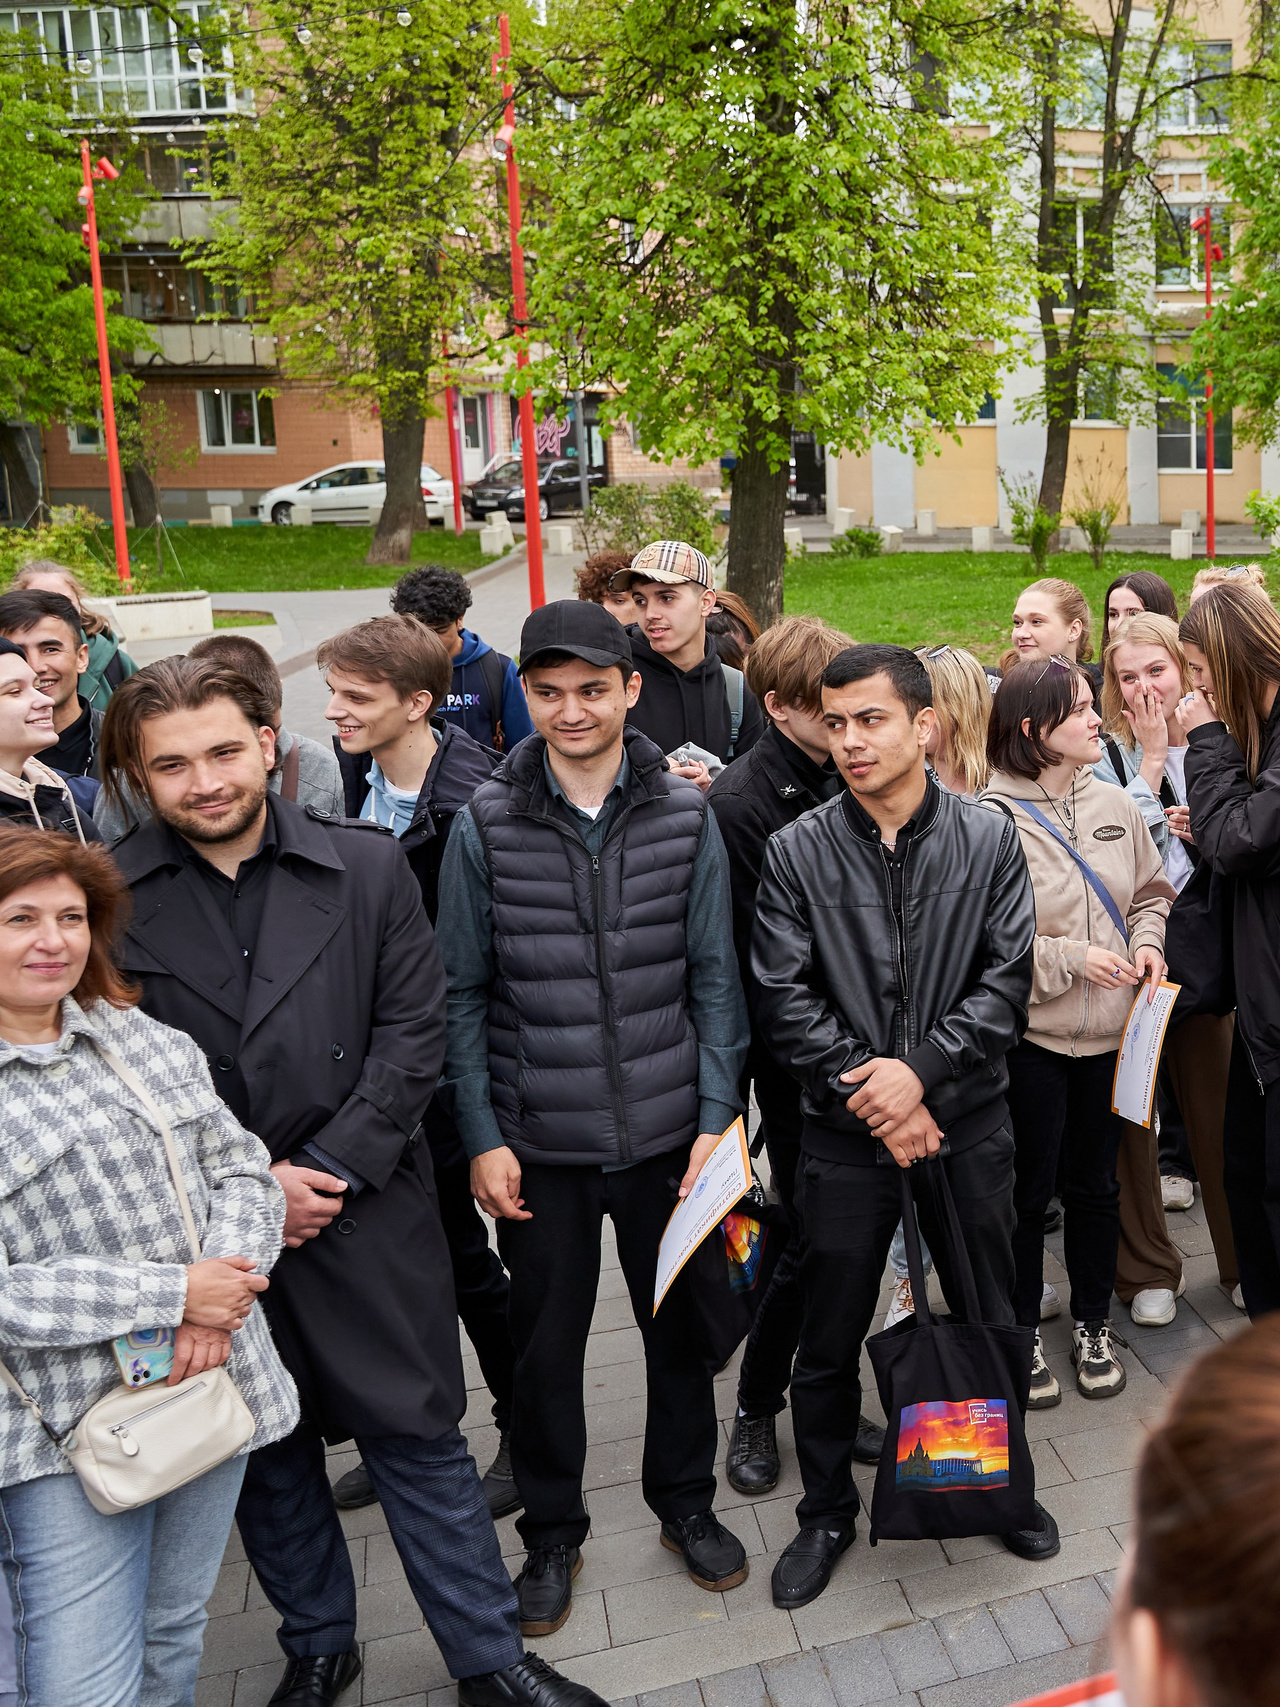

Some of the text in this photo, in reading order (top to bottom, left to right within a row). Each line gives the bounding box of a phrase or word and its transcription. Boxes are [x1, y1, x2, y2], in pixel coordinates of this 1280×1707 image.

[446, 694, 480, 706] PARK
[693, 1182, 742, 1241] Сертификат
[660, 1239, 693, 1290] участника
